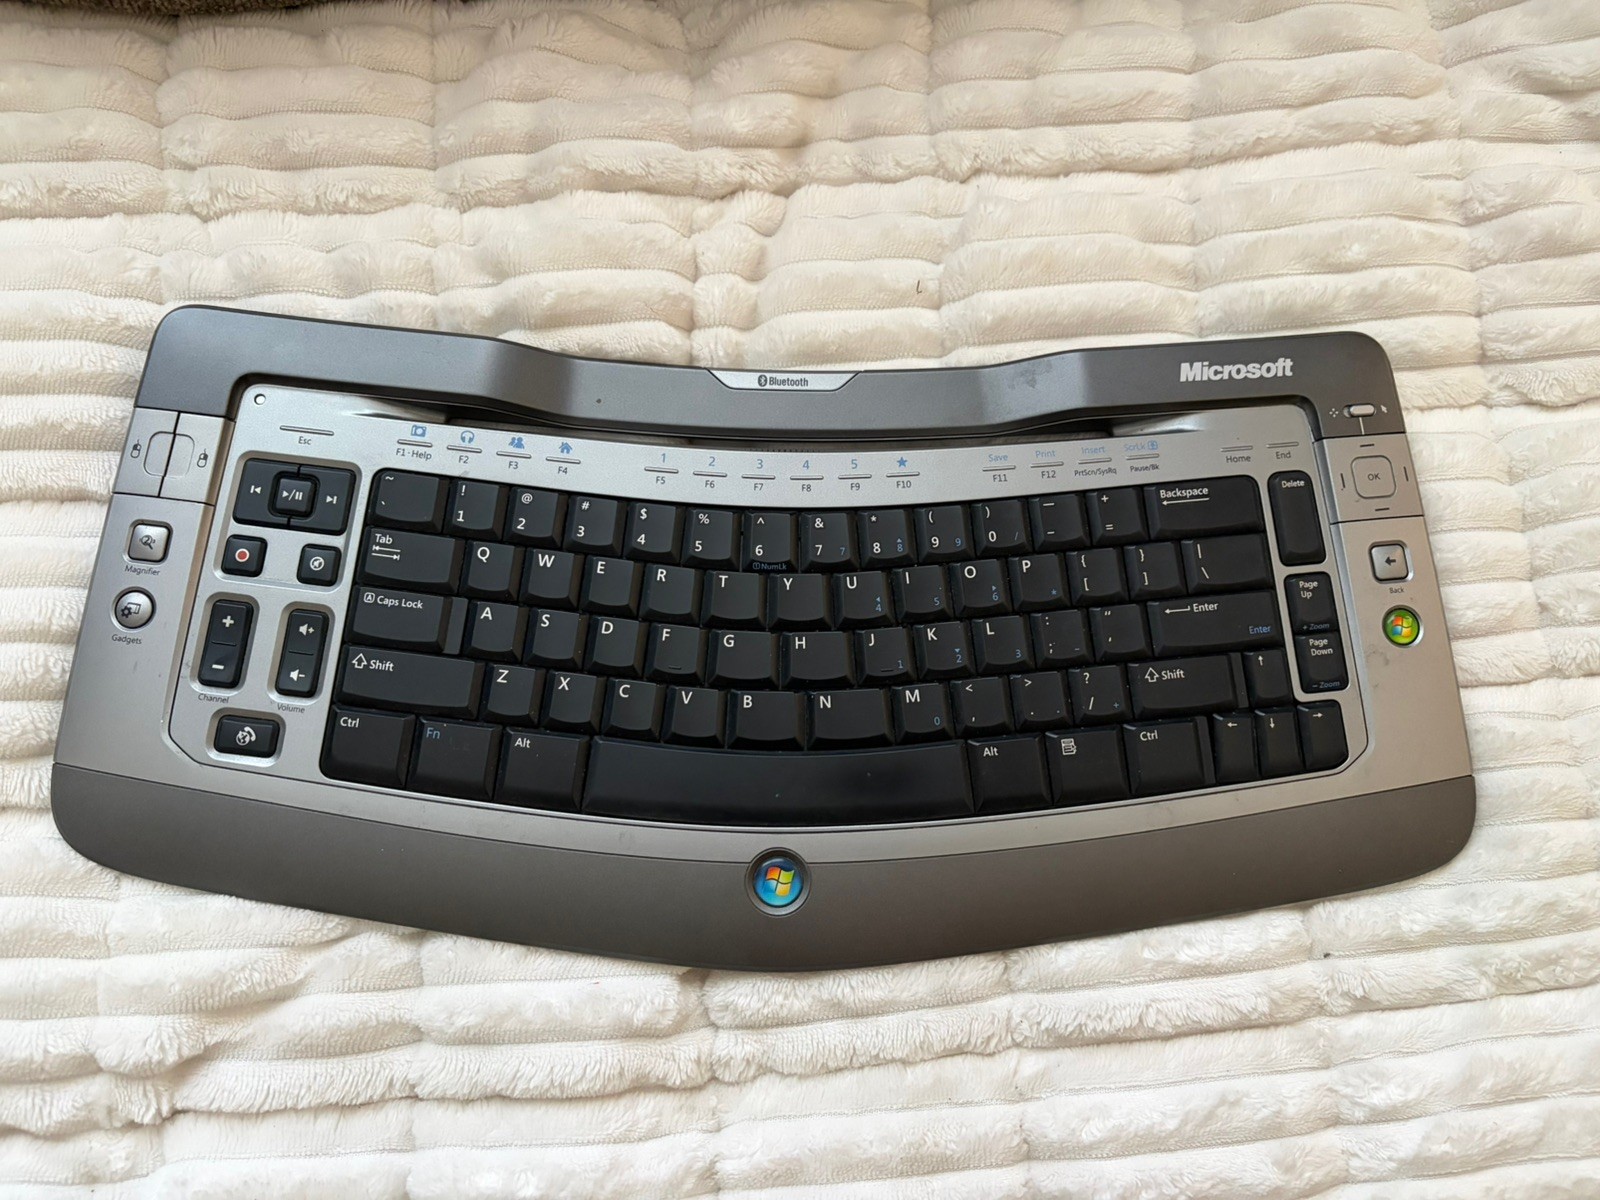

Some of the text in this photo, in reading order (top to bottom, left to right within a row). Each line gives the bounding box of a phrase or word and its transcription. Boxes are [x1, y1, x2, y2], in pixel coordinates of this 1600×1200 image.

[1180, 358, 1293, 382] Microsoft
[769, 376, 808, 387] Bluetooth
[298, 436, 311, 445] Esc
[1036, 450, 1056, 458] Print
[1081, 446, 1106, 454] Insert
[1276, 451, 1291, 459] End
[458, 455, 469, 464] F2
[661, 453, 666, 463] 1
[708, 457, 715, 466] 2
[851, 459, 858, 468] 5
[1226, 455, 1251, 463] Home
[508, 461, 519, 470] F3
[757, 459, 763, 469] 3
[802, 460, 810, 470] 4
[558, 466, 568, 475] F4
[656, 476, 666, 484] F5
[705, 480, 715, 488] F6
[896, 481, 911, 489] F10
[461, 485, 465, 496] !
[850, 483, 860, 491] F9
[1160, 487, 1209, 498] Backspace
[522, 494, 532, 504] @
[581, 501, 590, 510] #
[457, 511, 464, 522] 1
[640, 508, 647, 520] $
[928, 511, 934, 523] (
[985, 507, 990, 518] )
[517, 518, 525, 529] 2
[699, 514, 710, 524] %
[815, 518, 824, 528] &
[577, 526, 584, 537] 3
[375, 534, 393, 544] Tab
[637, 534, 646, 545] 4
[931, 537, 939, 548] 9
[694, 541, 702, 552] 5
[755, 545, 763, 556] 6
[815, 545, 822, 555] 7
[873, 543, 881, 554] 8
[477, 547, 490, 562] Q
[538, 554, 555, 567] W
[1022, 560, 1031, 572] P
[125, 565, 160, 576] Magnifier
[597, 562, 606, 574] E
[964, 566, 976, 578] O
[657, 569, 666, 581] R
[1143, 572, 1148, 585] ]
[719, 575, 728, 587] T
[783, 578, 793, 590] Y
[846, 577, 856, 589] U
[1084, 578, 1089, 591] [
[1301, 591, 1312, 599] Up
[377, 596, 423, 609] Caps Lock
[934, 597, 940, 605] 5
[1193, 602, 1218, 612] Enter
[480, 607, 493, 620] A
[540, 614, 550, 627] S
[601, 622, 613, 634] D
[986, 623, 994, 635] L
[1249, 625, 1271, 634] Enter
[112, 634, 142, 645] Gadgets
[662, 629, 671, 641] F
[927, 628, 937, 640] K
[724, 635, 735, 647] G
[795, 637, 806, 649] H
[868, 634, 875, 646] J
[1309, 638, 1328, 646] Page
[1311, 648, 1333, 656] Down
[369, 660, 394, 672] Shift
[497, 670, 509, 683] Z
[1083, 673, 1090, 684] ?
[1161, 670, 1185, 680] Shift
[558, 677, 570, 690] X
[619, 685, 630, 697] C
[905, 690, 920, 703] M
[198, 694, 229, 704] Channel
[682, 691, 693, 704] V
[743, 696, 753, 708] B
[820, 696, 832, 708] N
[277, 704, 305, 713] Volume
[340, 717, 359, 728] Ctrl
[426, 728, 440, 739] Fn
[1140, 730, 1158, 741] Ctrl
[515, 738, 531, 748] Alt
[983, 747, 998, 757] Alt
